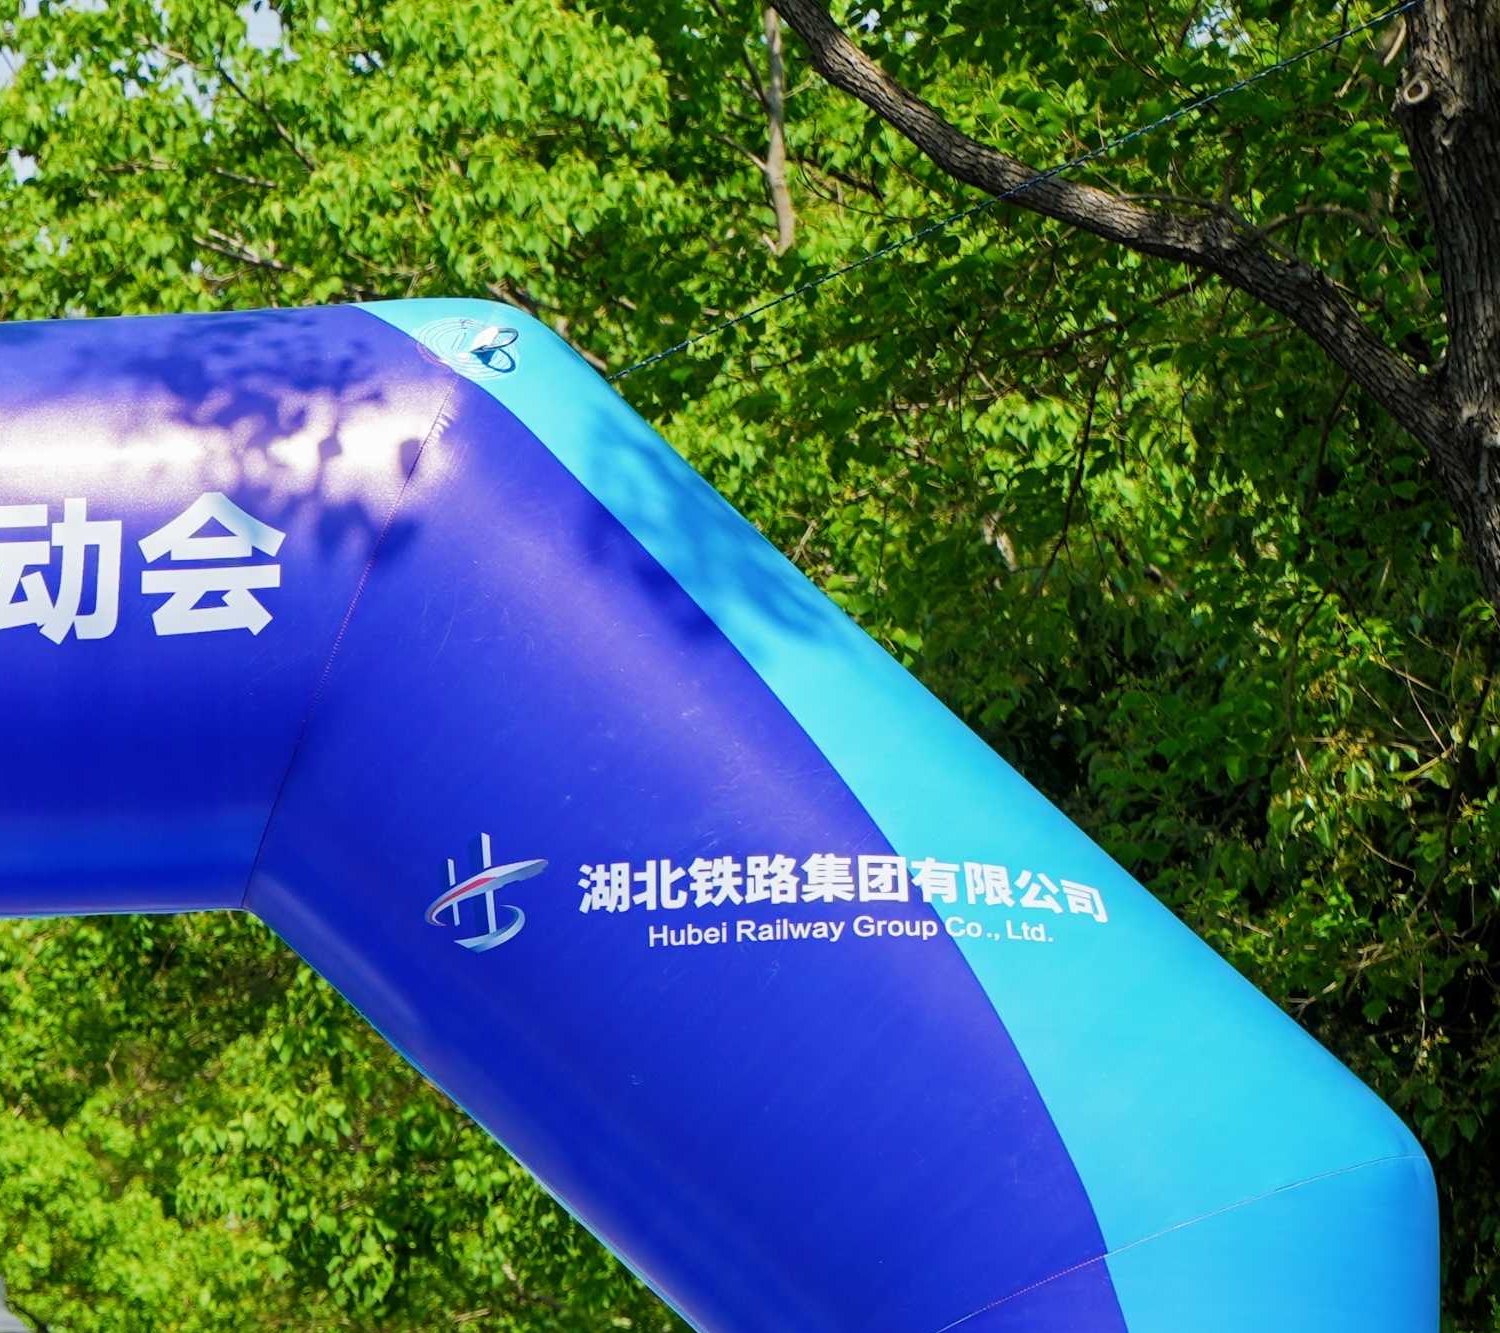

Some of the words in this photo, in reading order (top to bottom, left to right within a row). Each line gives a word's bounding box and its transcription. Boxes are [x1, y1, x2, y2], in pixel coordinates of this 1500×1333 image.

[577, 853, 1109, 923] 湖北铁路集团有限公司
[647, 922, 728, 948] Hubei
[736, 916, 846, 945] Railway
[852, 914, 938, 942] Group
[1006, 919, 1055, 944] Ltd.
